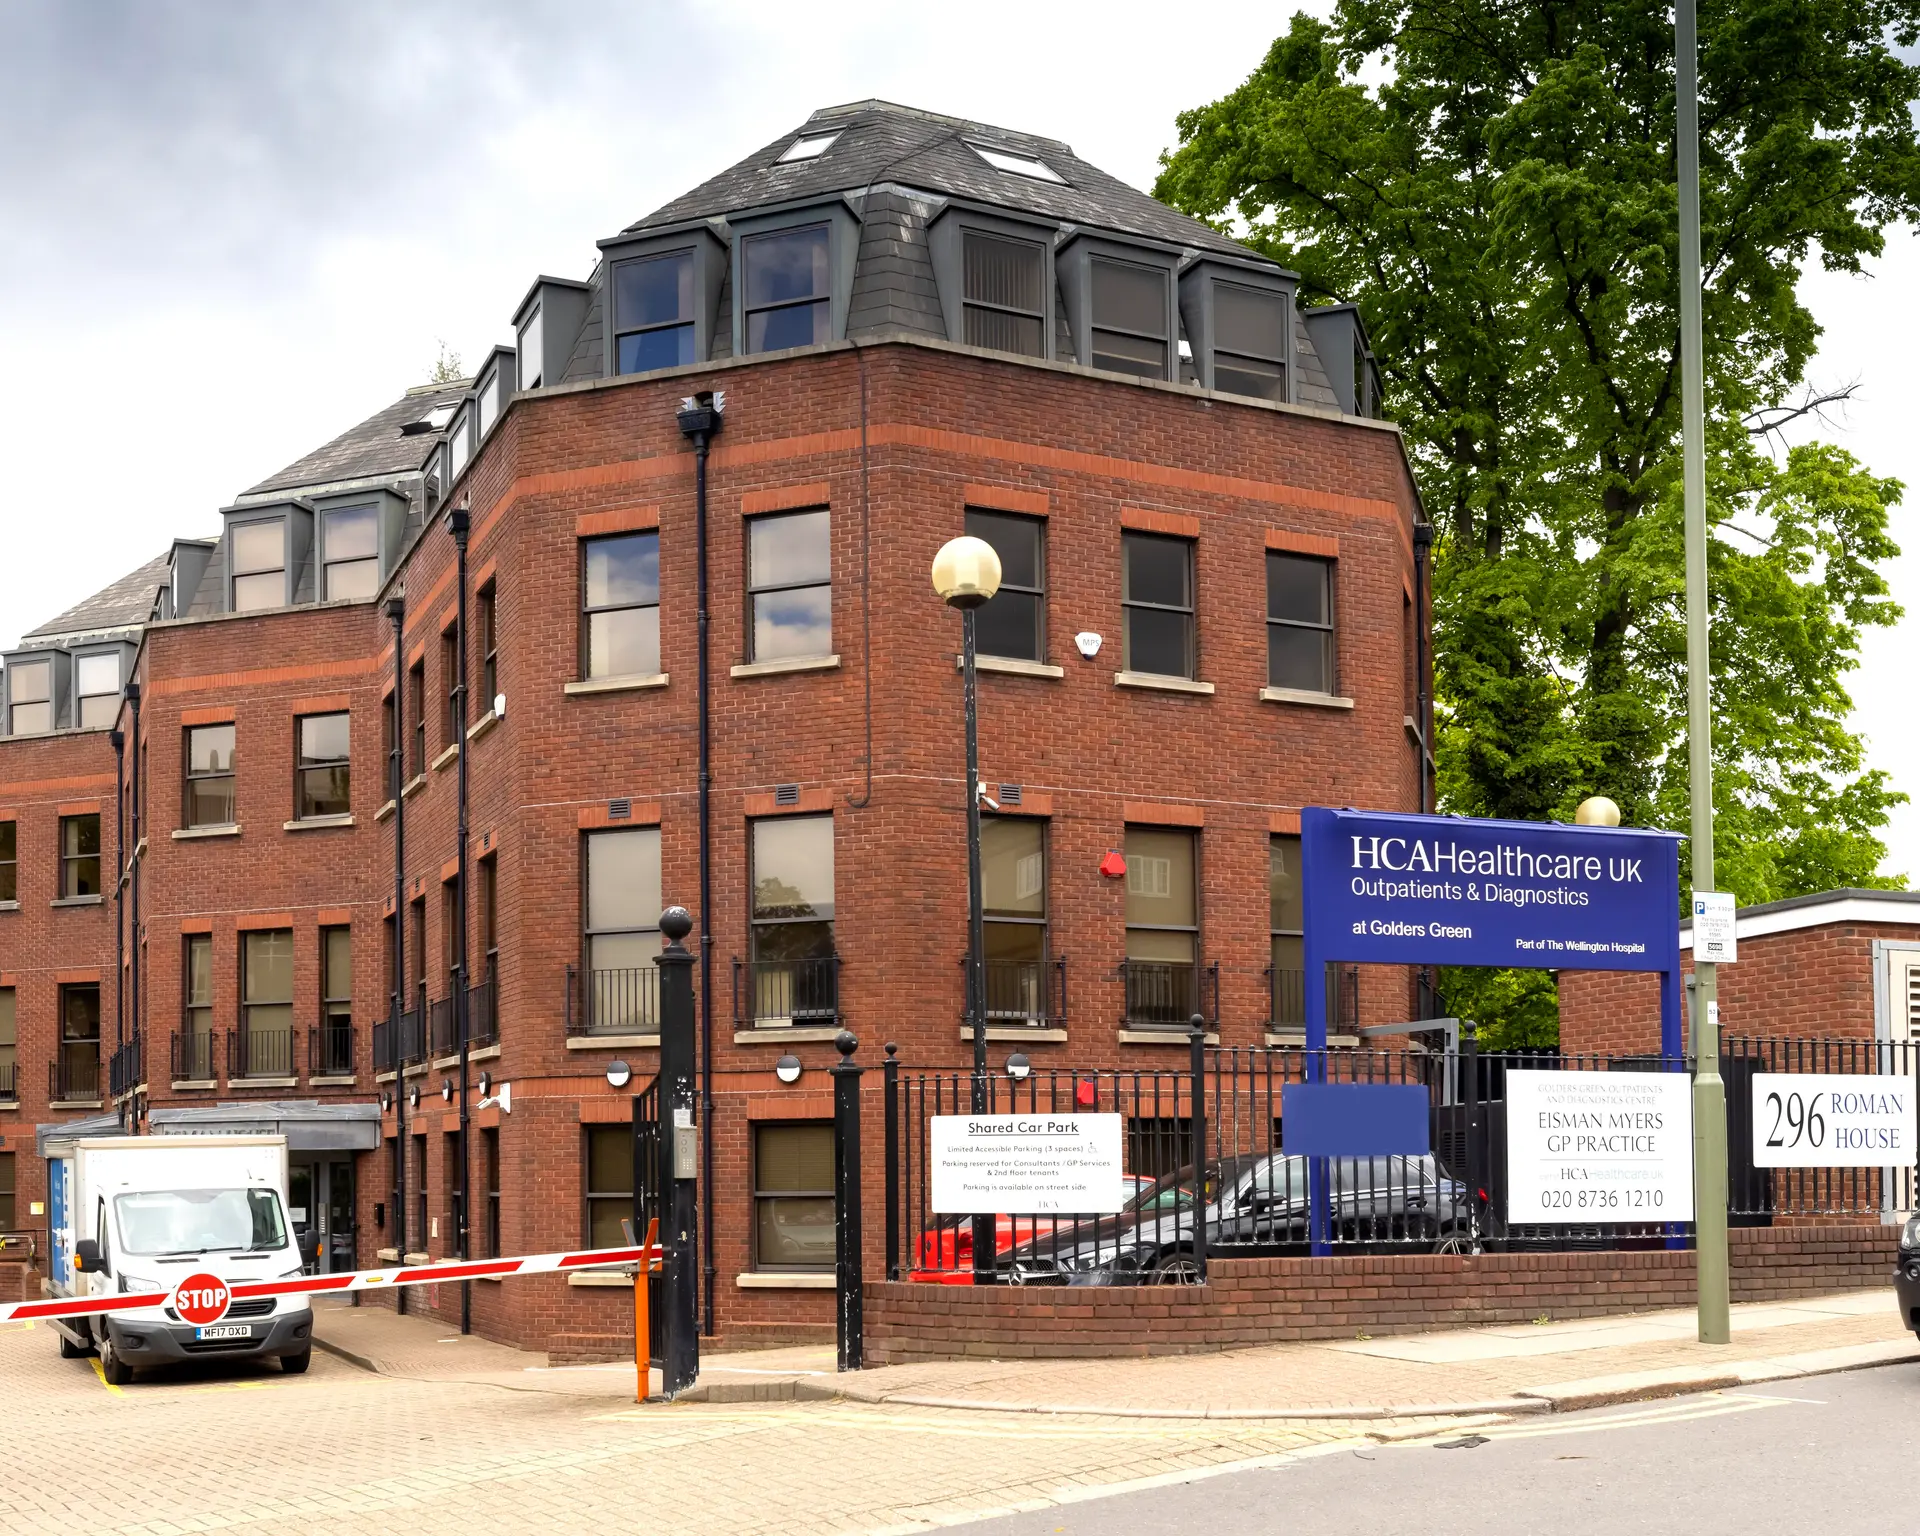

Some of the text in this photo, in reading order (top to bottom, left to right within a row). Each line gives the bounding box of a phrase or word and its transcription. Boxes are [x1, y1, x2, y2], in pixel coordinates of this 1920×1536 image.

[1610, 858, 1643, 883] UK
[1351, 876, 1589, 907] Outpatients & Diagnostics
[1352, 919, 1472, 939] at Golders Green
[1516, 938, 1645, 954] Part of The Wellington Hospital
[1538, 1084, 1663, 1095] GOLDERS GREEN OUTPATIENTS
[1547, 1095, 1656, 1106] AND DIAGNOSTICS CENTRE
[968, 1121, 1079, 1134] Shared Car Park
[1538, 1111, 1664, 1129] EISMAN MYERS
[1765, 1092, 1904, 1148] 296 ROMAN
[1547, 1135, 1656, 1152] GP PRACTICE
[1835, 1128, 1901, 1149] HOUSE
[948, 1145, 974, 1153] Limited
[975, 1145, 1011, 1153] Accessible
[1013, 1145, 1042, 1154] Parking
[1055, 1145, 1084, 1154] spaces)
[942, 1160, 968, 1168] Parking
[969, 1160, 999, 1168] reserved
[1001, 1159, 1012, 1167] for
[1013, 1159, 1060, 1167] Consultants
[1079, 1159, 1111, 1167] Services
[963, 1183, 990, 1192] Parking
[991, 1183, 998, 1191] is
[999, 1183, 1033, 1191] available
[1071, 1183, 1087, 1191] side
[1541, 1189, 1664, 1208] 020 8736 1210
[177, 1288, 227, 1310] STOP
[204, 1326, 248, 1337] MF17 OXD
